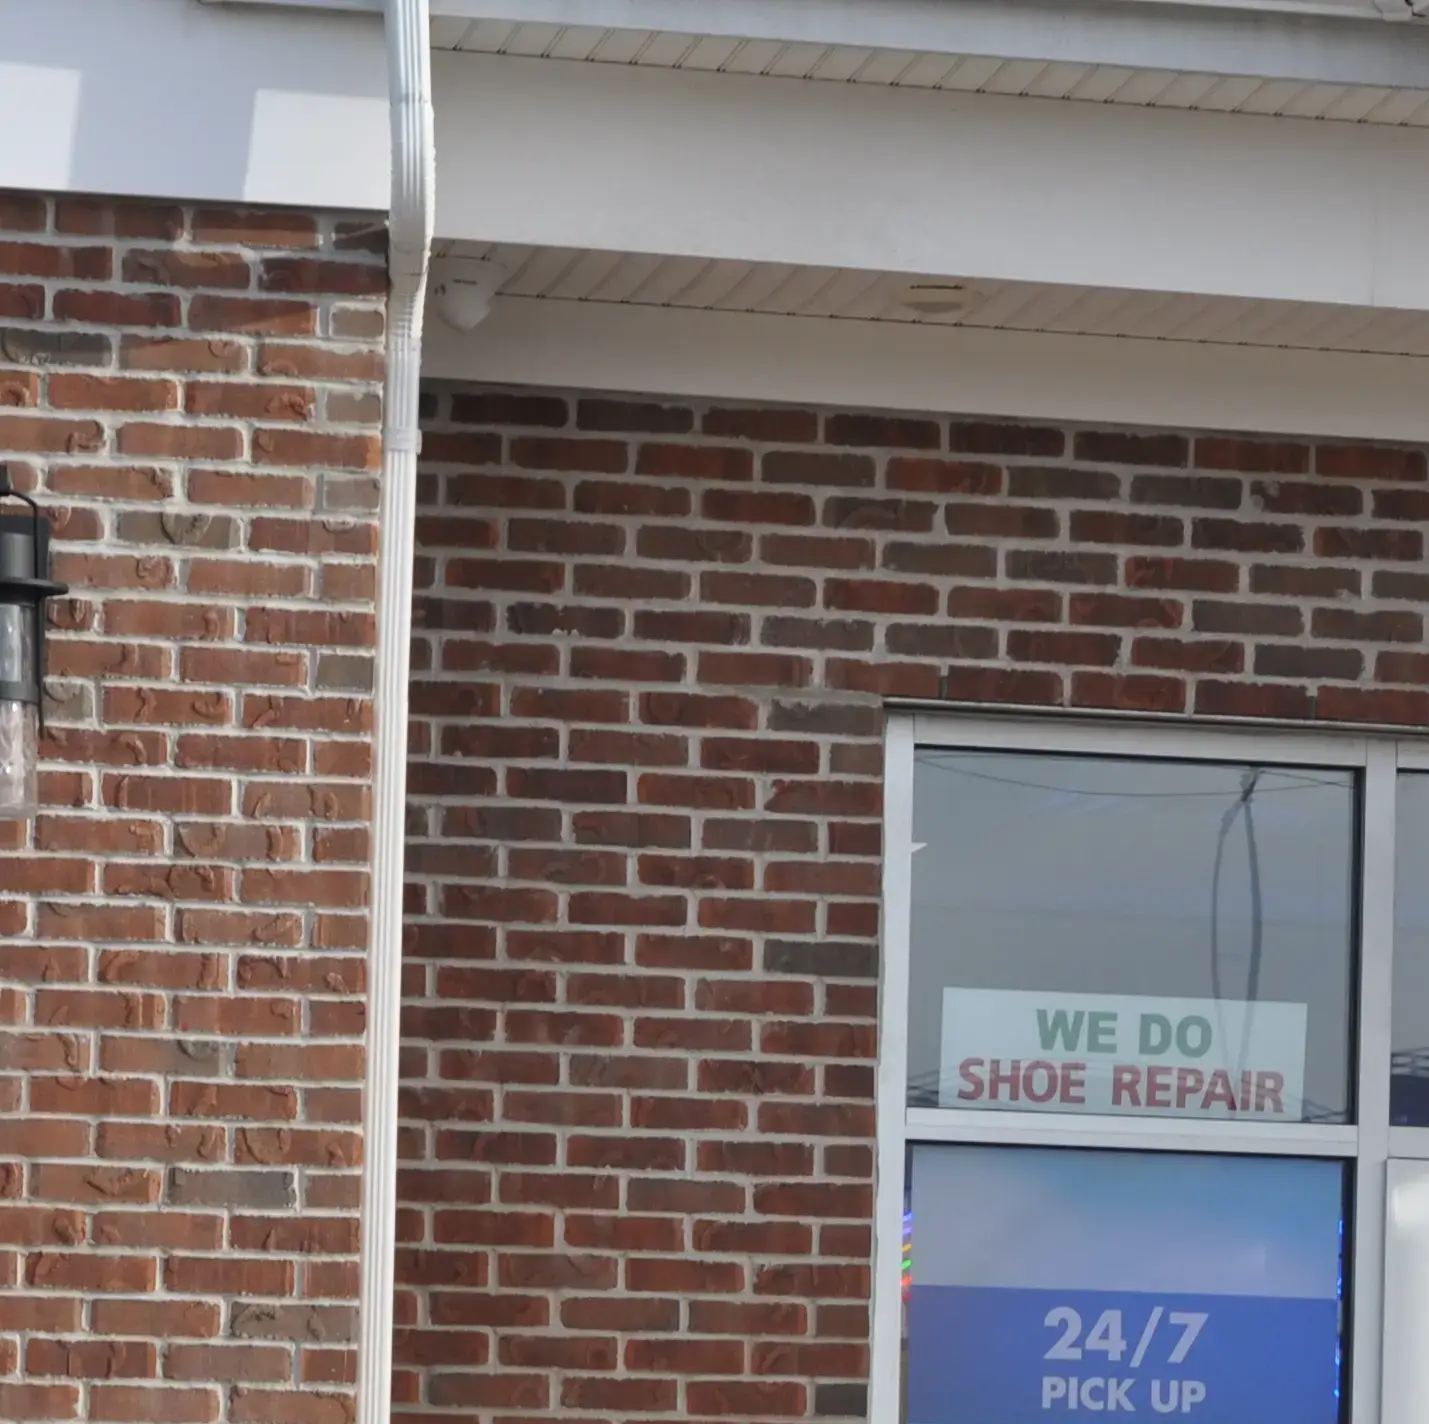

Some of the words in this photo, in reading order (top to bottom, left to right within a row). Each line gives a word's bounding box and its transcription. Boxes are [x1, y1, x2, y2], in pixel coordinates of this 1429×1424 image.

[1036, 1008, 1118, 1053] WE
[1138, 1013, 1212, 1058] DO
[957, 1057, 1086, 1104] SHOE
[1111, 1065, 1285, 1113] REPAIR
[1042, 1306, 1209, 1368] 24/7
[1041, 1376, 1136, 1412] PICK
[1150, 1379, 1206, 1414] UP
